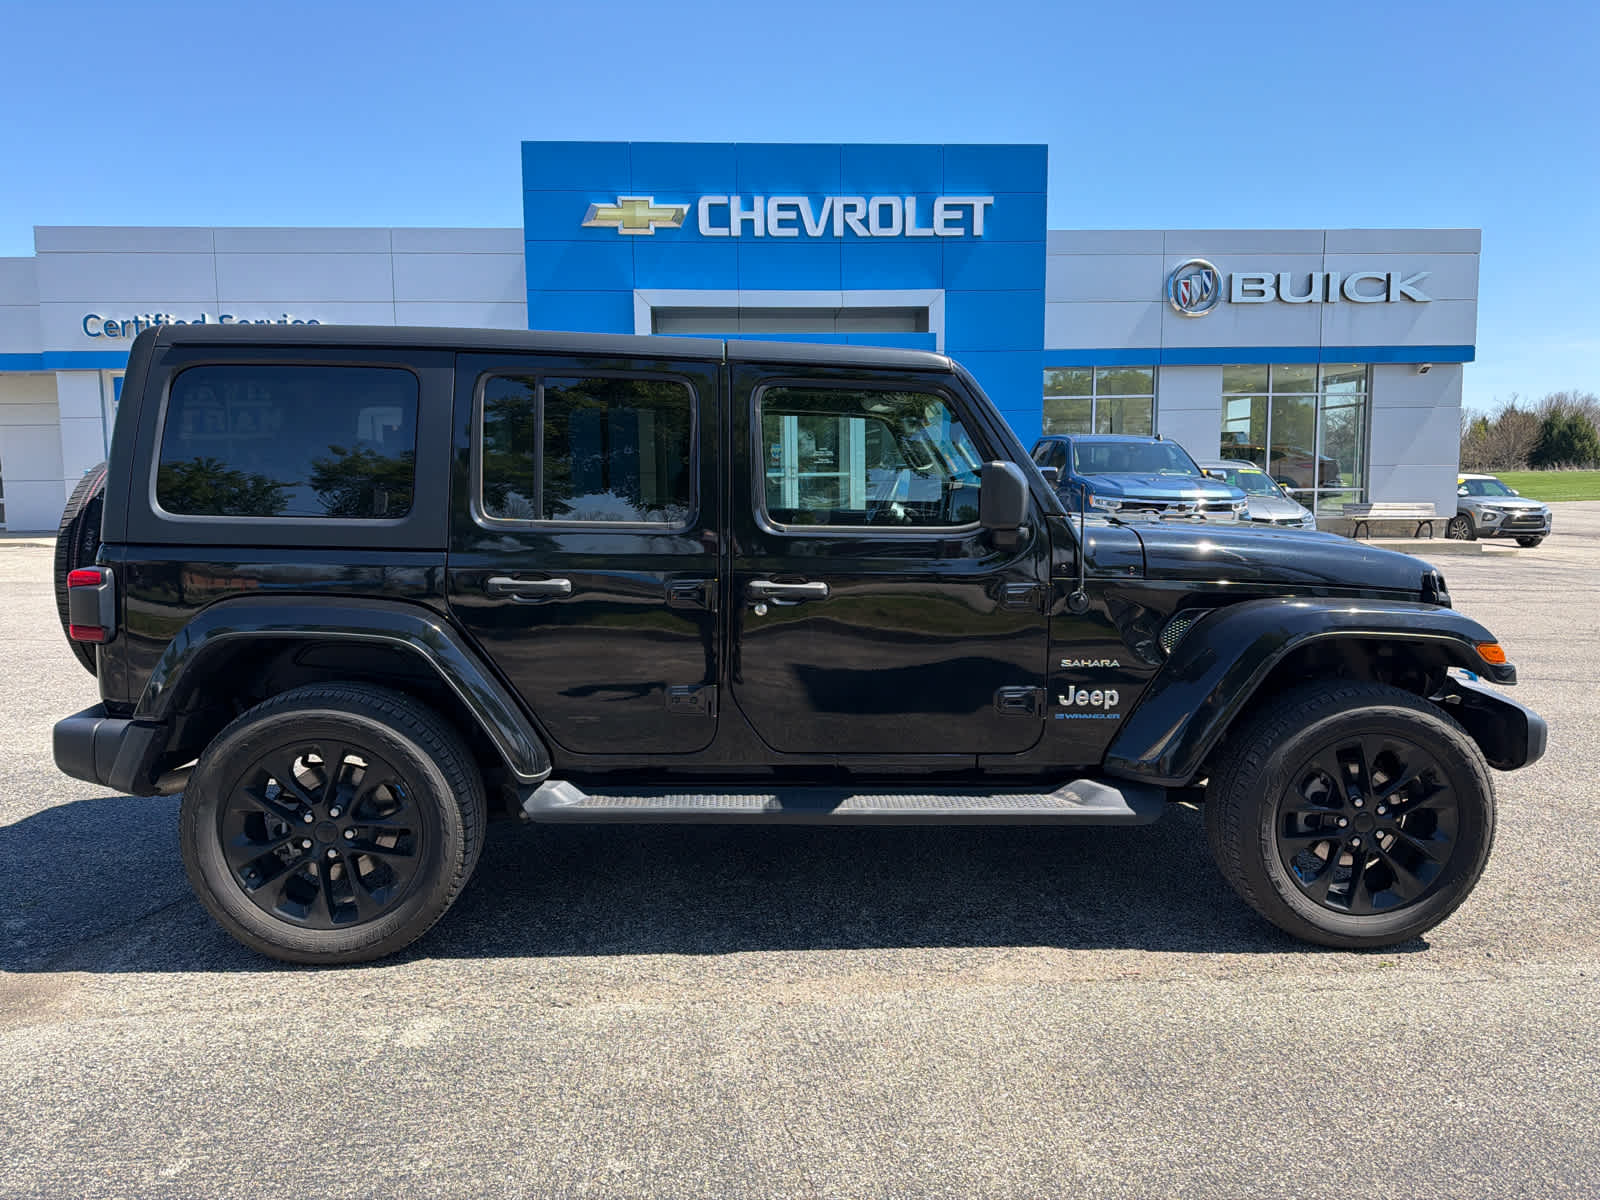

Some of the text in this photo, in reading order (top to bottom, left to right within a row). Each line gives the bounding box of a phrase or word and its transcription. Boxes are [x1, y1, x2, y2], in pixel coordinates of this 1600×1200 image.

[698, 195, 994, 237] CHEVROLET
[1230, 271, 1433, 303] BUICK
[82, 312, 206, 337] Certif
[1060, 658, 1120, 668] SAHARA
[1058, 685, 1120, 710] Jeep
